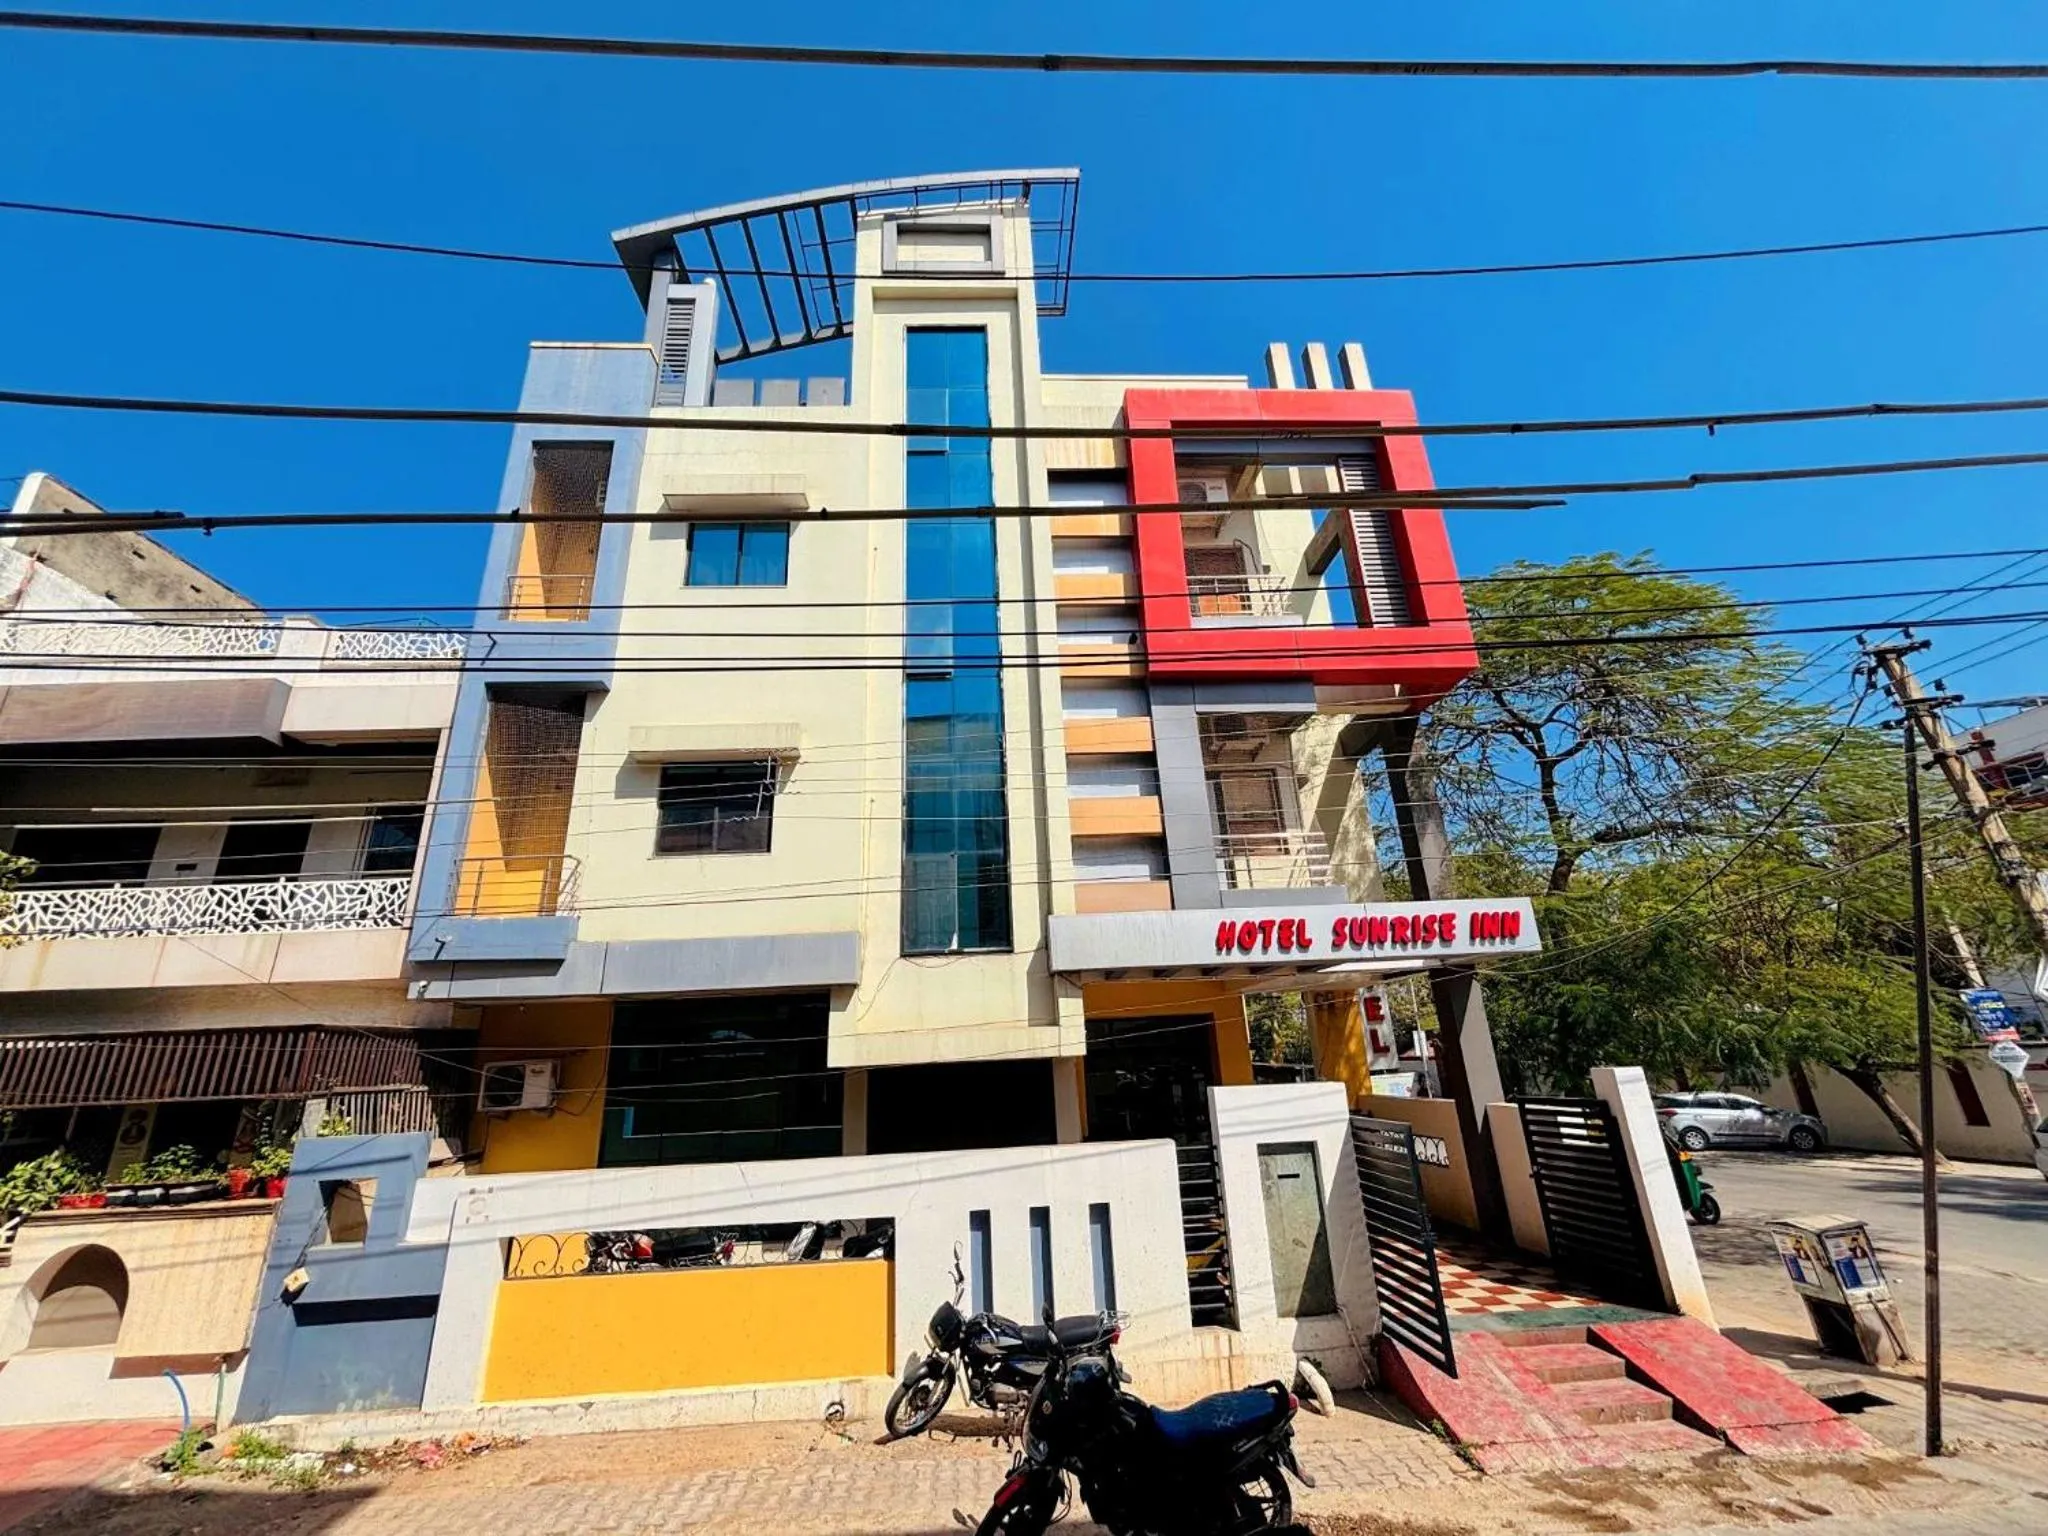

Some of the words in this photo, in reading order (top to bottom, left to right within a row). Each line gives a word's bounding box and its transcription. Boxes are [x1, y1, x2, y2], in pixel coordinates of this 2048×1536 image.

[1216, 918, 1312, 952] HOTEL
[1332, 913, 1457, 947] SUNRISE
[1469, 910, 1520, 942] INN
